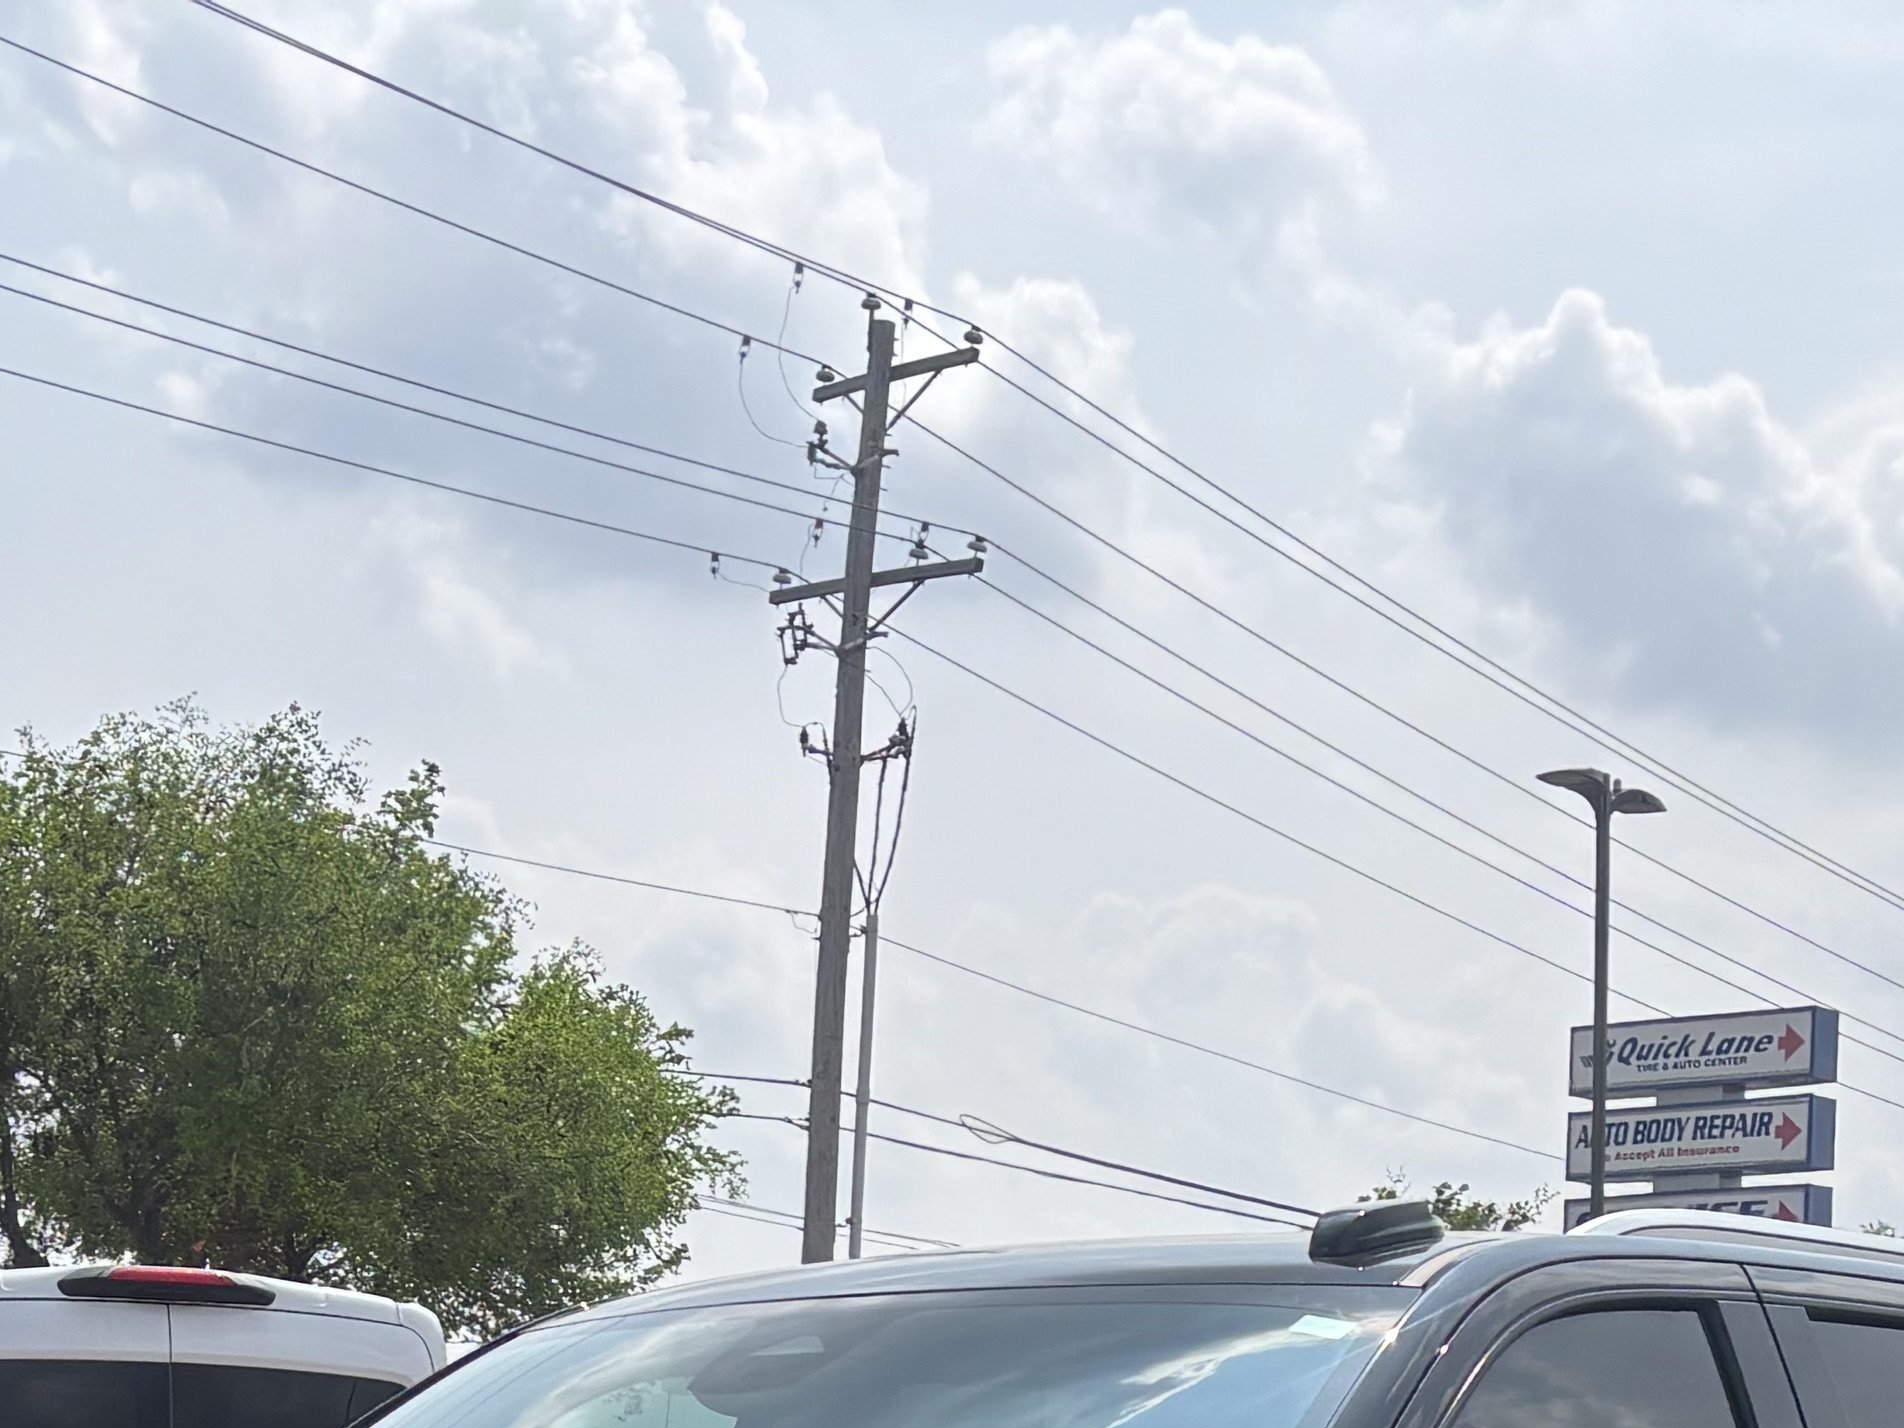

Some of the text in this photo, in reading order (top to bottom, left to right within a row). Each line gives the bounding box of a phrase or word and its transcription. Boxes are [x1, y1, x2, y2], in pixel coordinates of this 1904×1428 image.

[1617, 1031, 1774, 1066] Quick Lane
[1636, 1062, 1660, 1073] TIRE
[1672, 1059, 1701, 1070] AUTO
[1704, 1056, 1748, 1067] CENTER
[1575, 1112, 1774, 1149] ATO BODY REPAIR
[1614, 1151, 1655, 1162] Accept
[1677, 1145, 1740, 1157] Insurance
